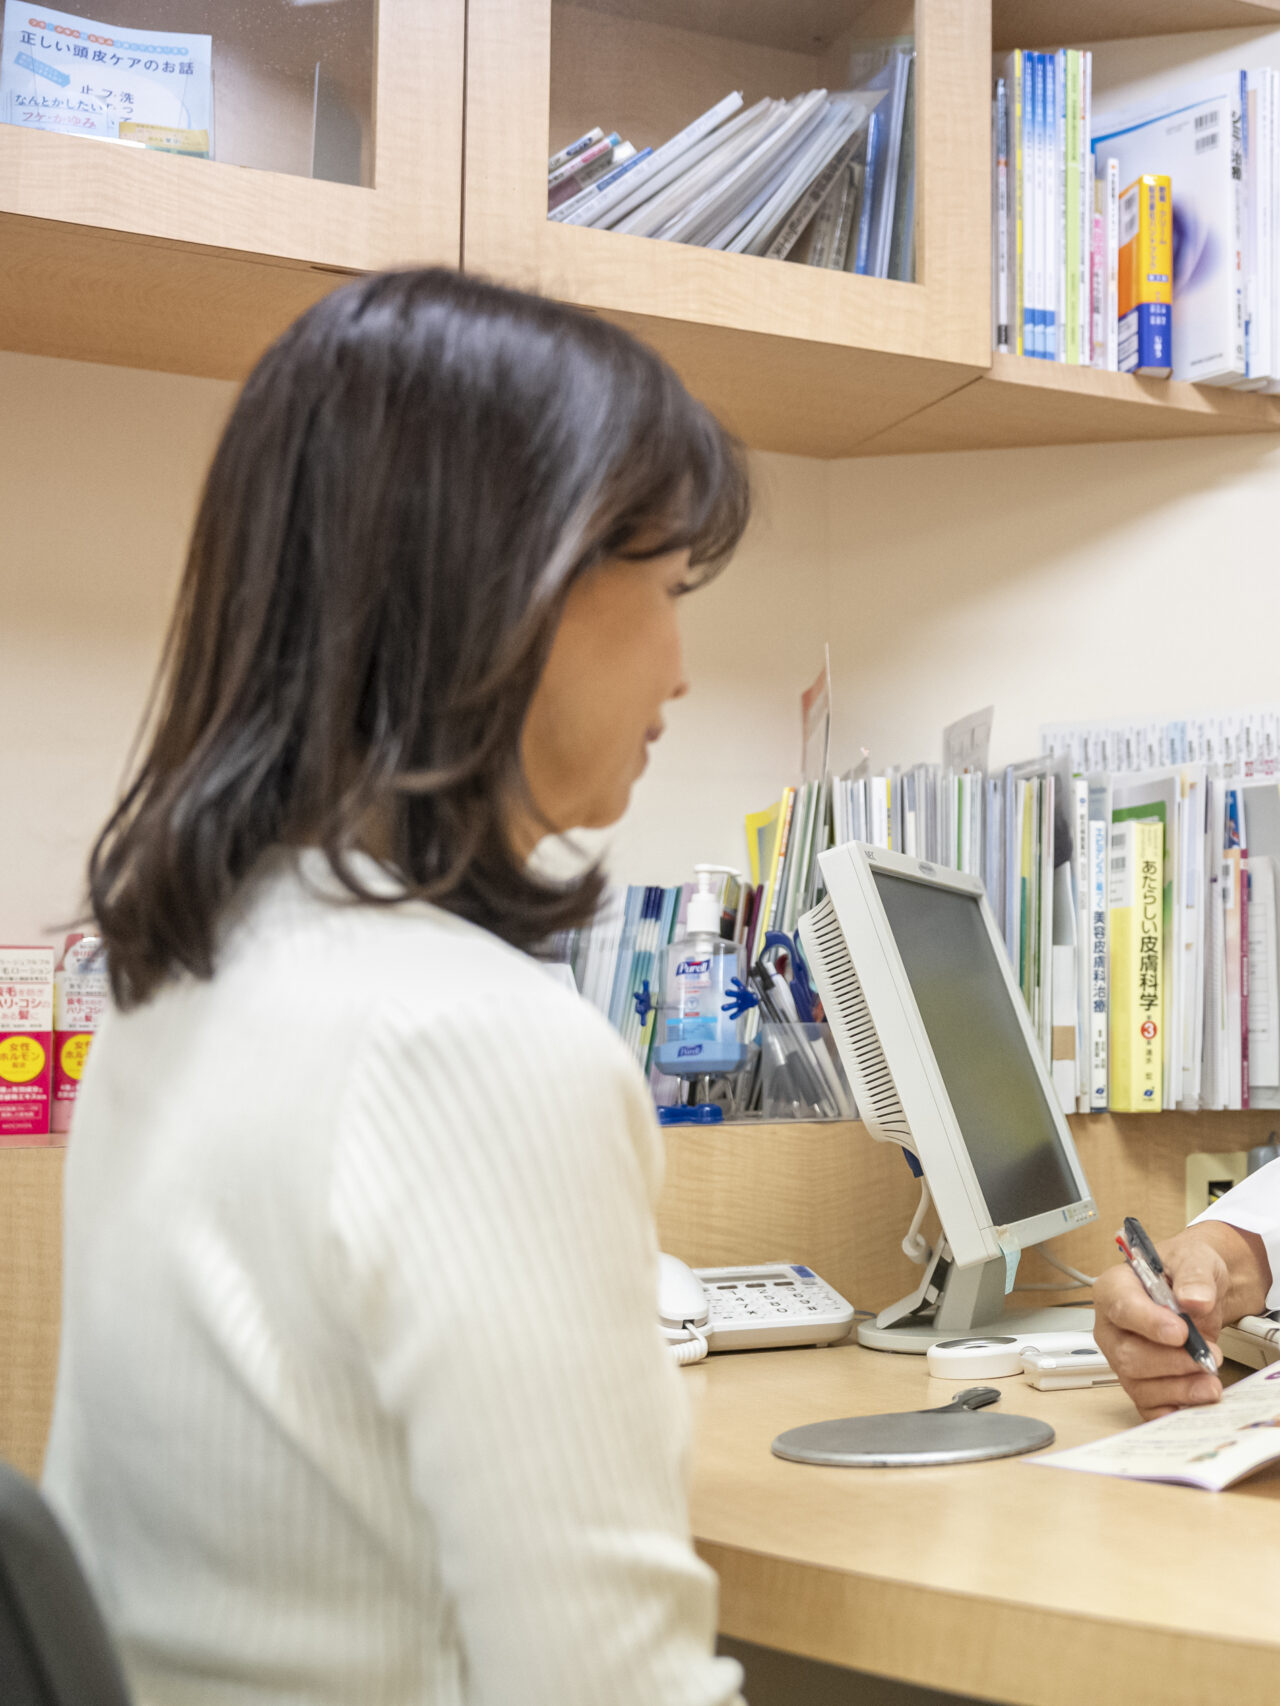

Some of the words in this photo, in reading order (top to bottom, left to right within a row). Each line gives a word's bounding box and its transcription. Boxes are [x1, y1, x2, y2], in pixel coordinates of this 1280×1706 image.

[20, 30, 194, 75] 正しい頭皮ケアのお話
[1139, 861, 1159, 1011] あたらしい皮膚科学
